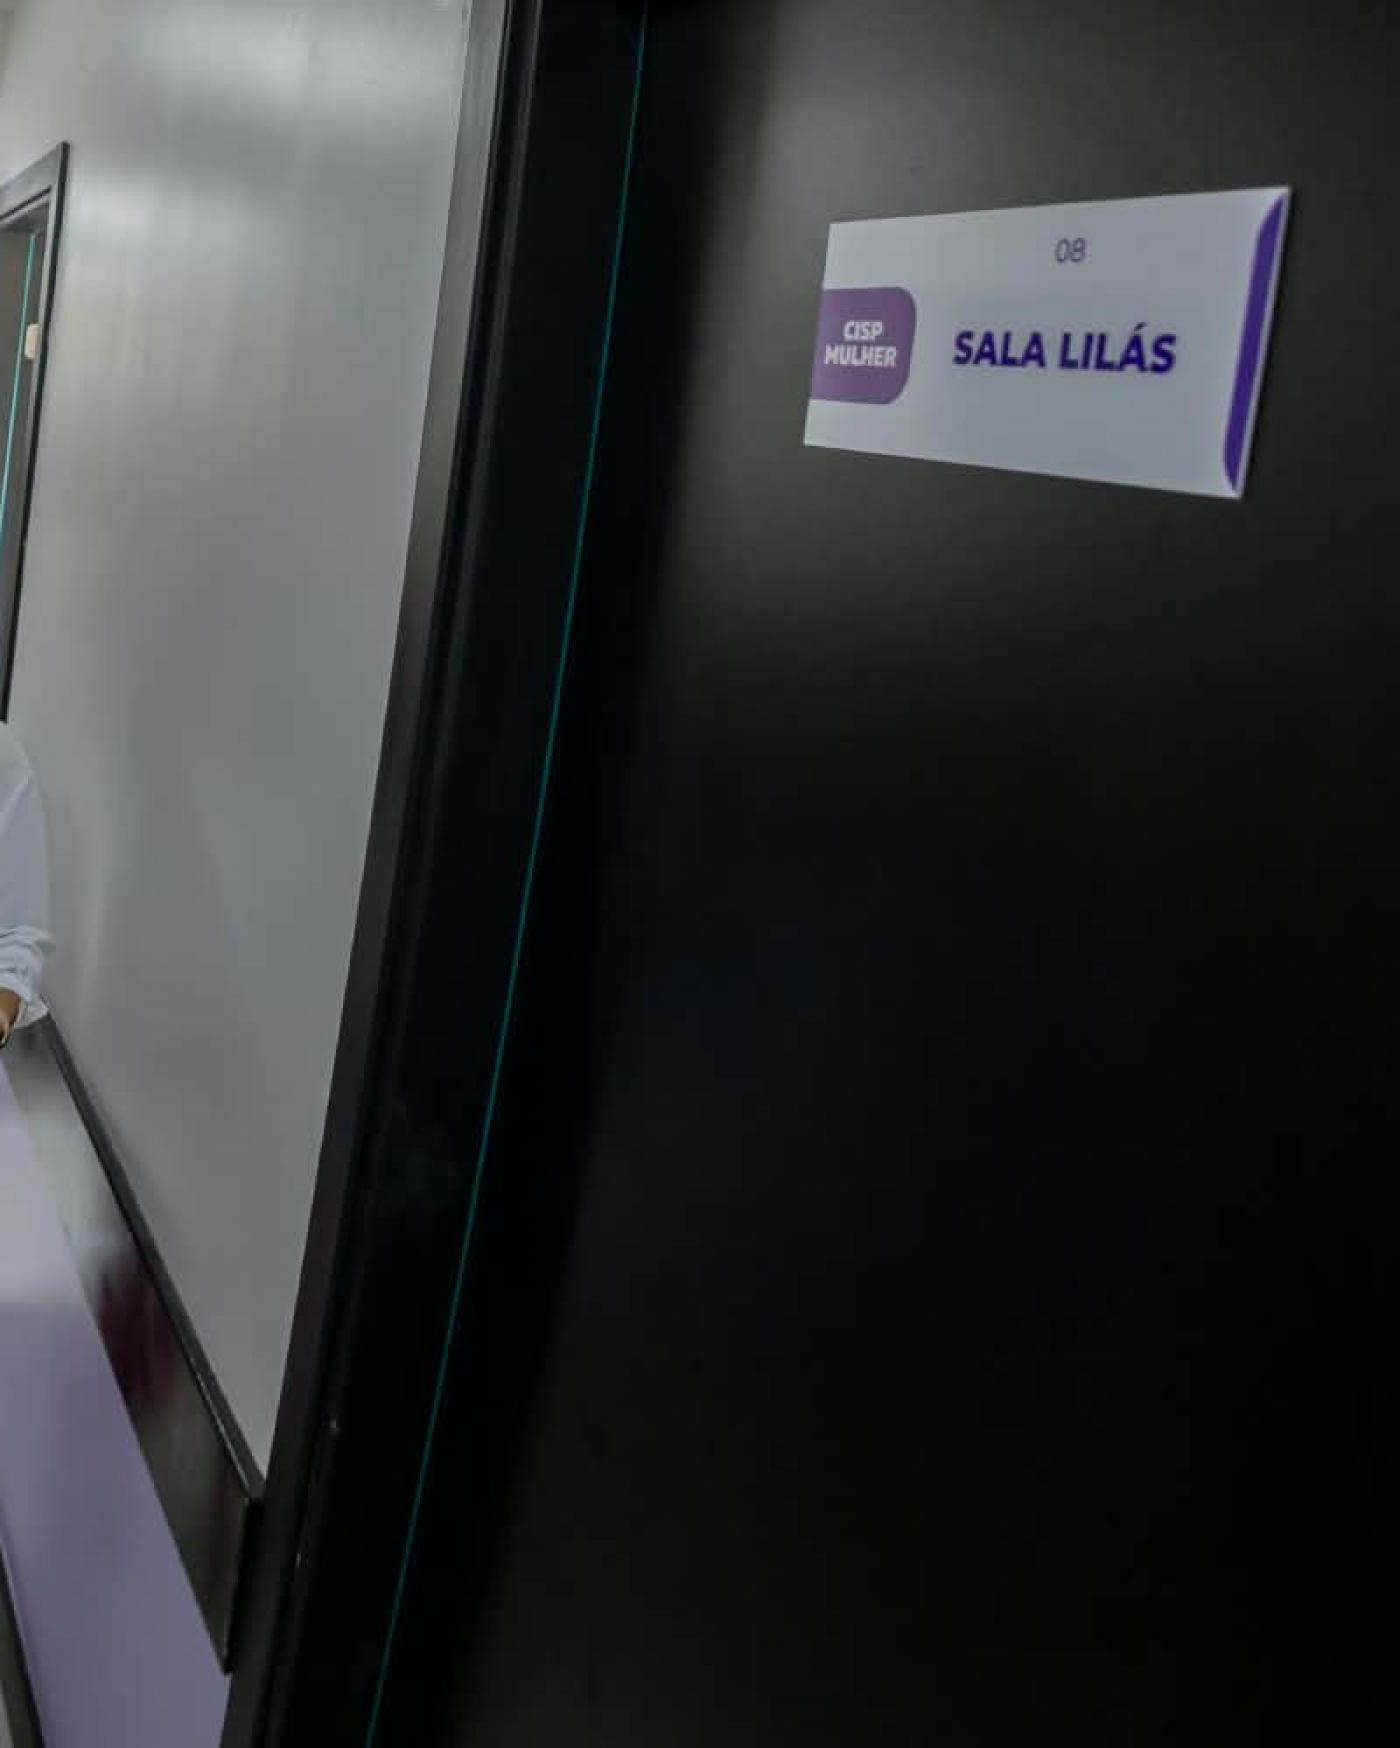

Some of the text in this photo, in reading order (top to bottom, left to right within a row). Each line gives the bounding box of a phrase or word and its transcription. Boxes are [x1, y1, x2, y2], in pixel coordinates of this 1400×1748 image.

[1054, 238, 1086, 263] 08
[843, 320, 883, 340] CISP
[823, 344, 897, 368] MULHER
[953, 322, 1177, 374] SALA LILÁS
